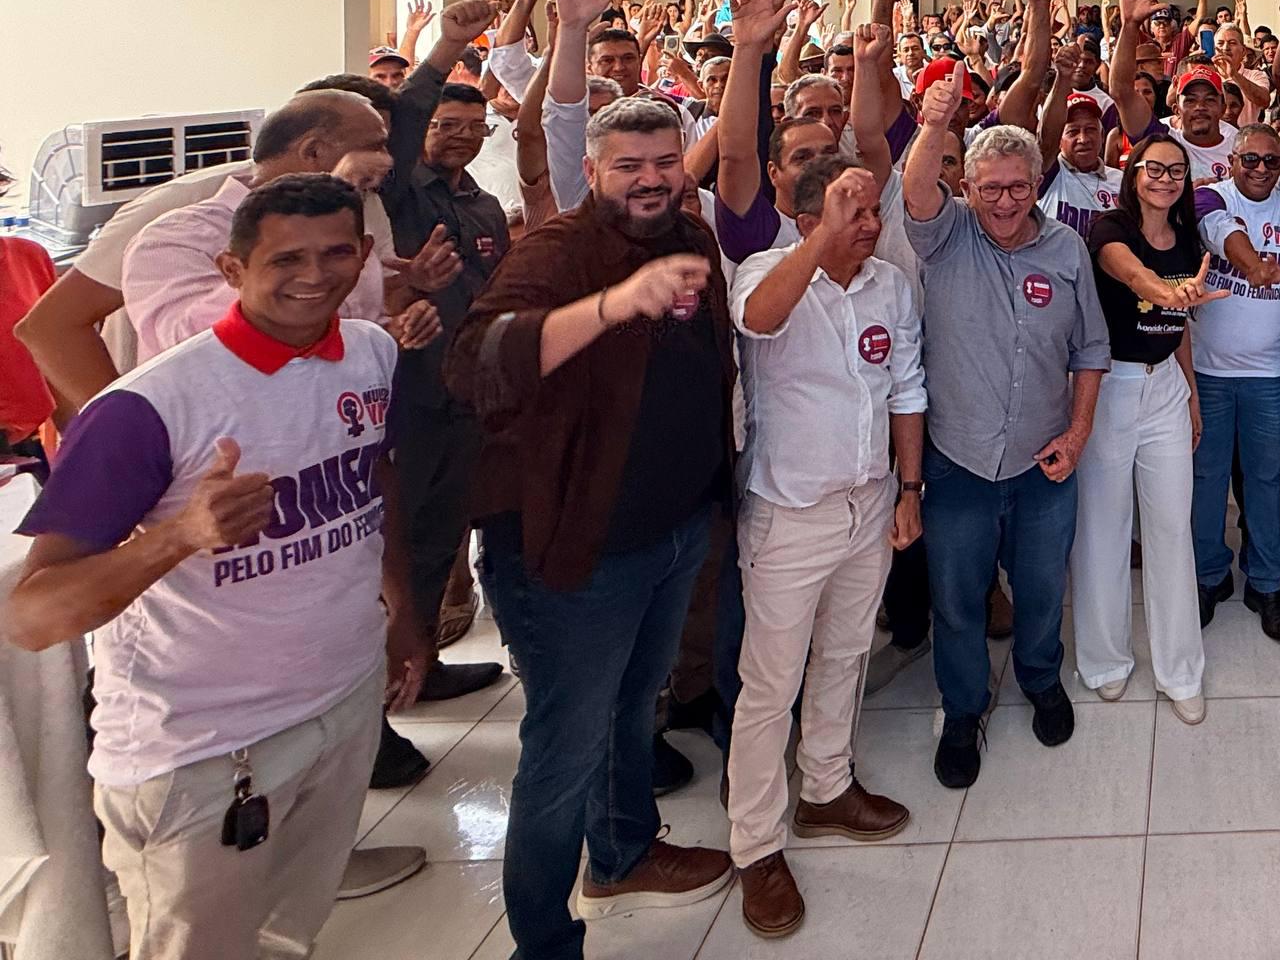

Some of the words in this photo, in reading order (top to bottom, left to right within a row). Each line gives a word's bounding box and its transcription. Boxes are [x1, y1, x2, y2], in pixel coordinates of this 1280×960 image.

[1233, 282, 1246, 297] DO
[214, 549, 275, 587] PELO
[280, 534, 322, 569] FIM
[328, 522, 353, 554] DO
